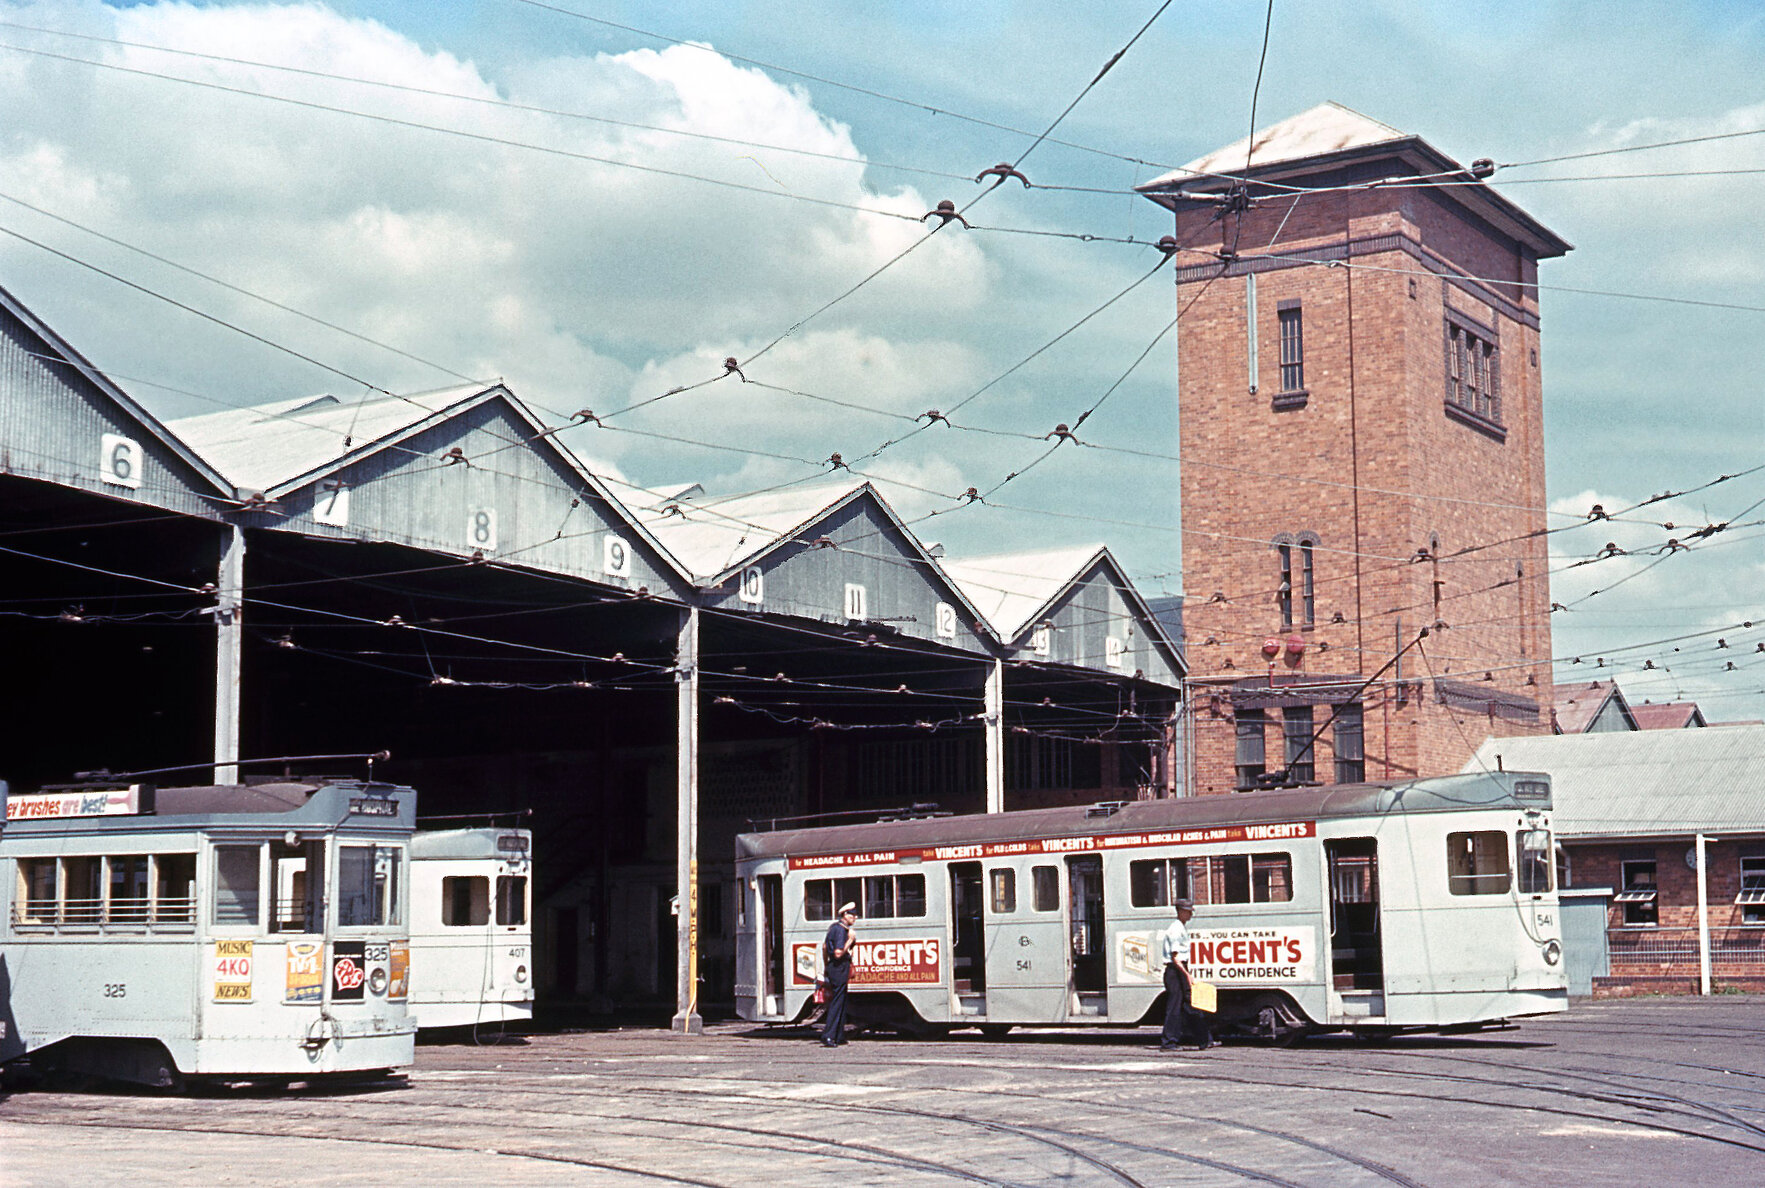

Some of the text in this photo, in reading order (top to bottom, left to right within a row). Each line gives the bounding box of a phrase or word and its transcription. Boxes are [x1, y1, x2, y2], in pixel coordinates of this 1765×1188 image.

[111, 443, 131, 479] 6
[322, 478, 345, 516] 7
[475, 511, 489, 543] 8
[611, 543, 625, 570] 9
[743, 568, 759, 597] 10
[851, 589, 861, 615] 11
[940, 610, 953, 633] 12
[19, 797, 61, 816] brushes
[62, 799, 80, 815] are
[803, 856, 844, 866] HEADACHE
[854, 854, 871, 863] ALL
[874, 852, 895, 861] PAIN
[1210, 830, 1227, 839] PAIN
[1537, 914, 1553, 926] 541
[1231, 931, 1249, 939] CAN
[218, 942, 250, 954] MUSIC
[365, 947, 388, 961] 325
[509, 949, 525, 959] 407
[1190, 936, 1302, 965] INCENT'S
[870, 965, 912, 973] CONFIDENCE
[1016, 960, 1032, 971] 541
[1219, 966, 1296, 978] CONFIDENCE
[851, 971, 896, 982] EADACHE
[921, 972, 936, 980] PAIN
[104, 984, 126, 998] 325
[216, 985, 249, 998] NEWS
